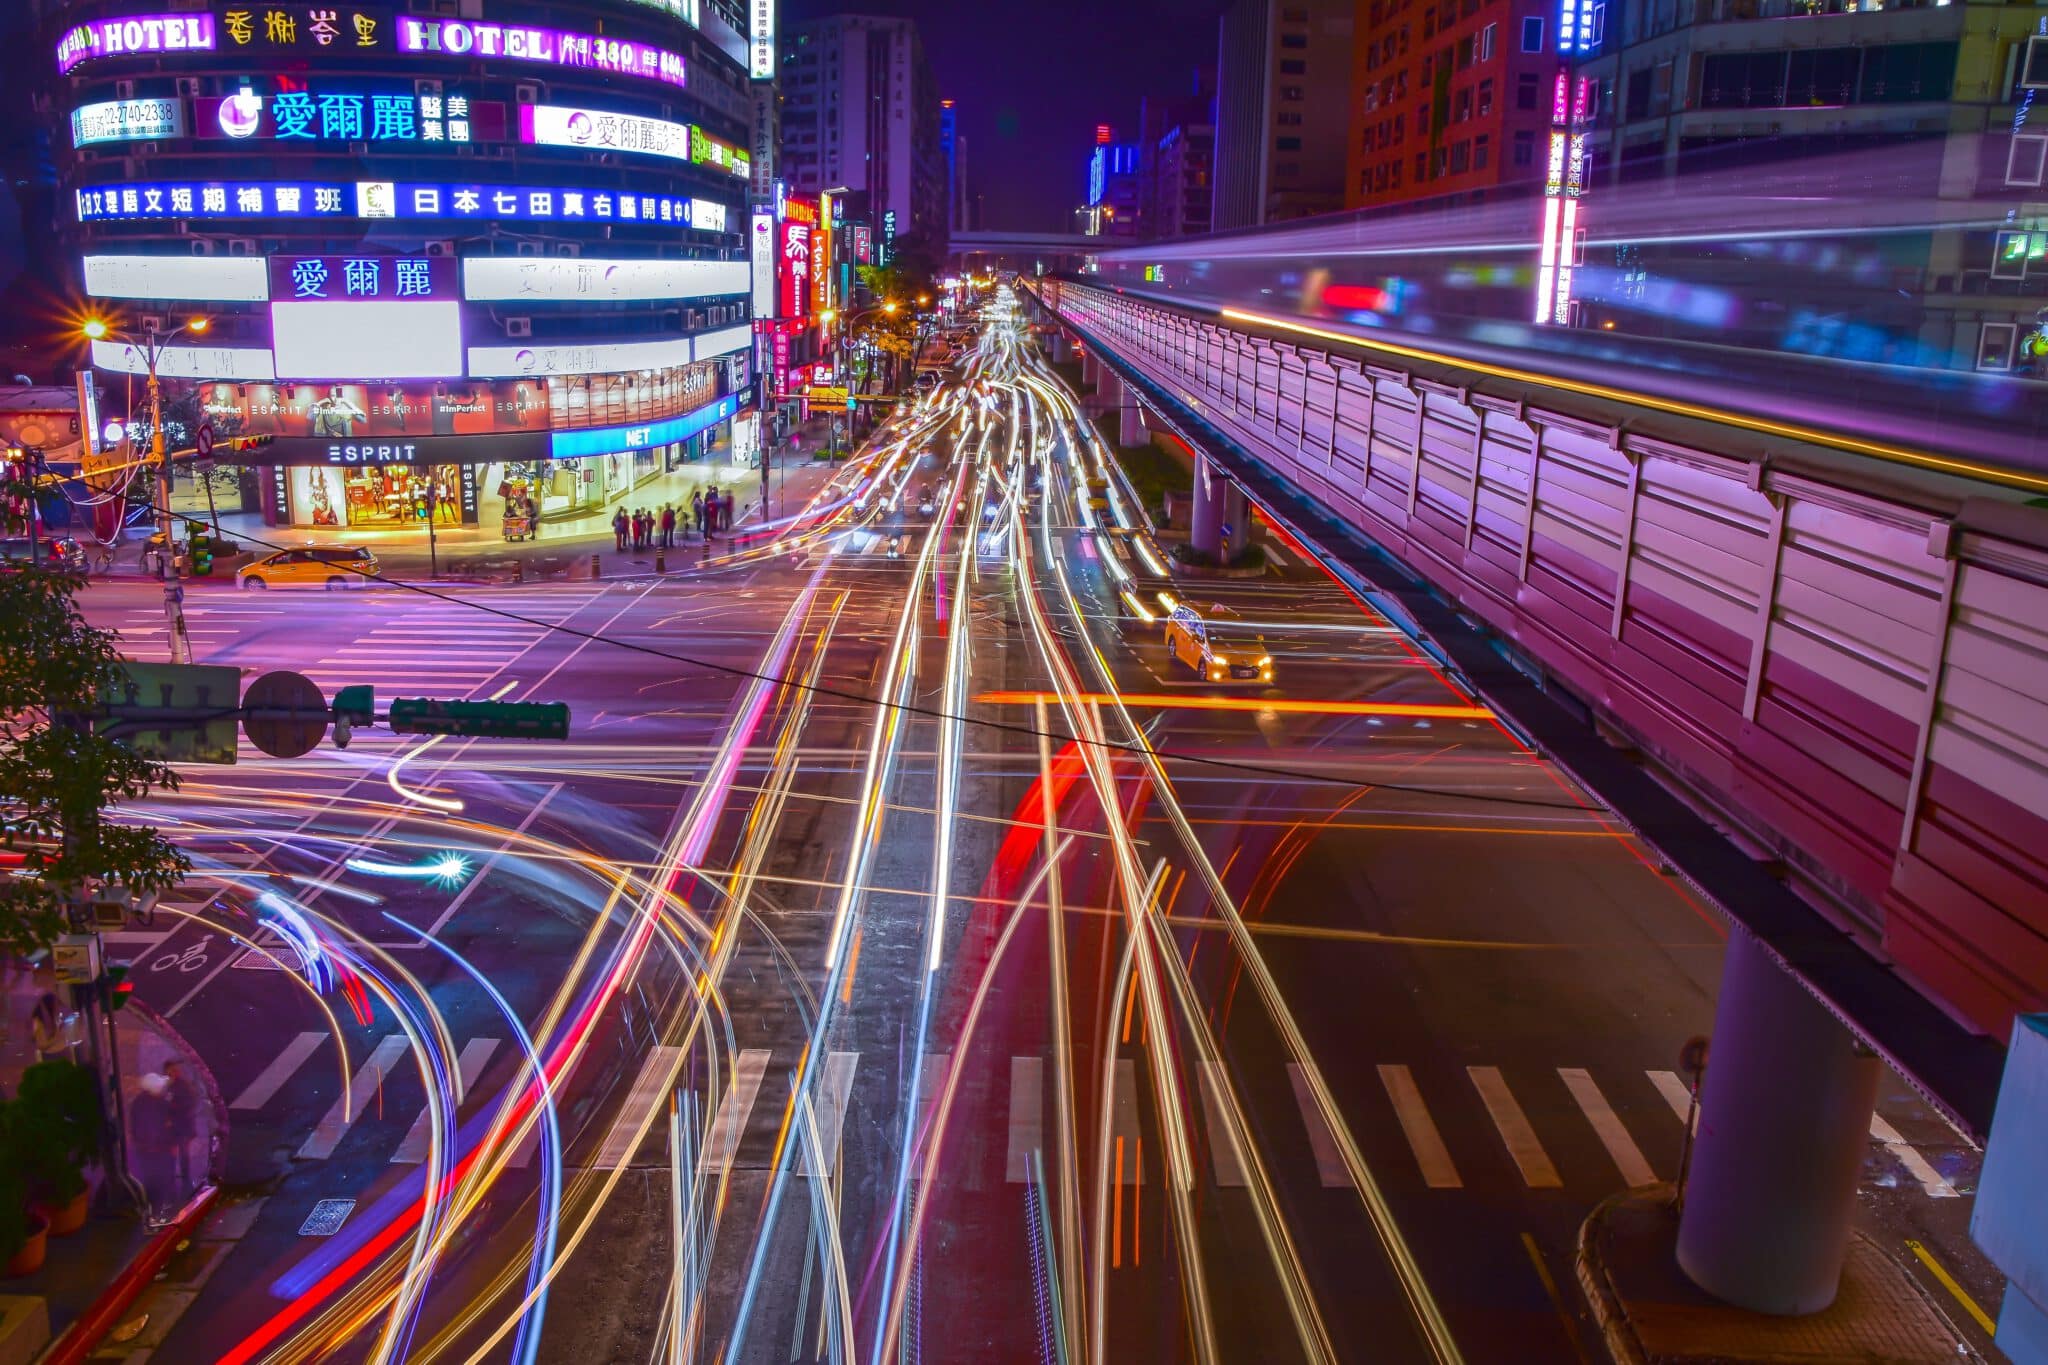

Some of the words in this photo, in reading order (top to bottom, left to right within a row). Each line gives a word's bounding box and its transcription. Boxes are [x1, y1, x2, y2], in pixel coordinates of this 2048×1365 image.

[104, 18, 210, 51] HOTEL
[407, 21, 551, 60] HOTEL
[273, 93, 416, 140] 愛爾麗
[292, 259, 432, 298] 愛爾麗
[813, 236, 824, 283] TASTY
[440, 404, 486, 413] #ImPerfect
[497, 401, 546, 412] ESPRIT
[329, 445, 415, 461] ESPRIT
[626, 428, 651, 447] NET
[275, 464, 285, 513] ESPRIT
[463, 463, 474, 512] ESPRIT
